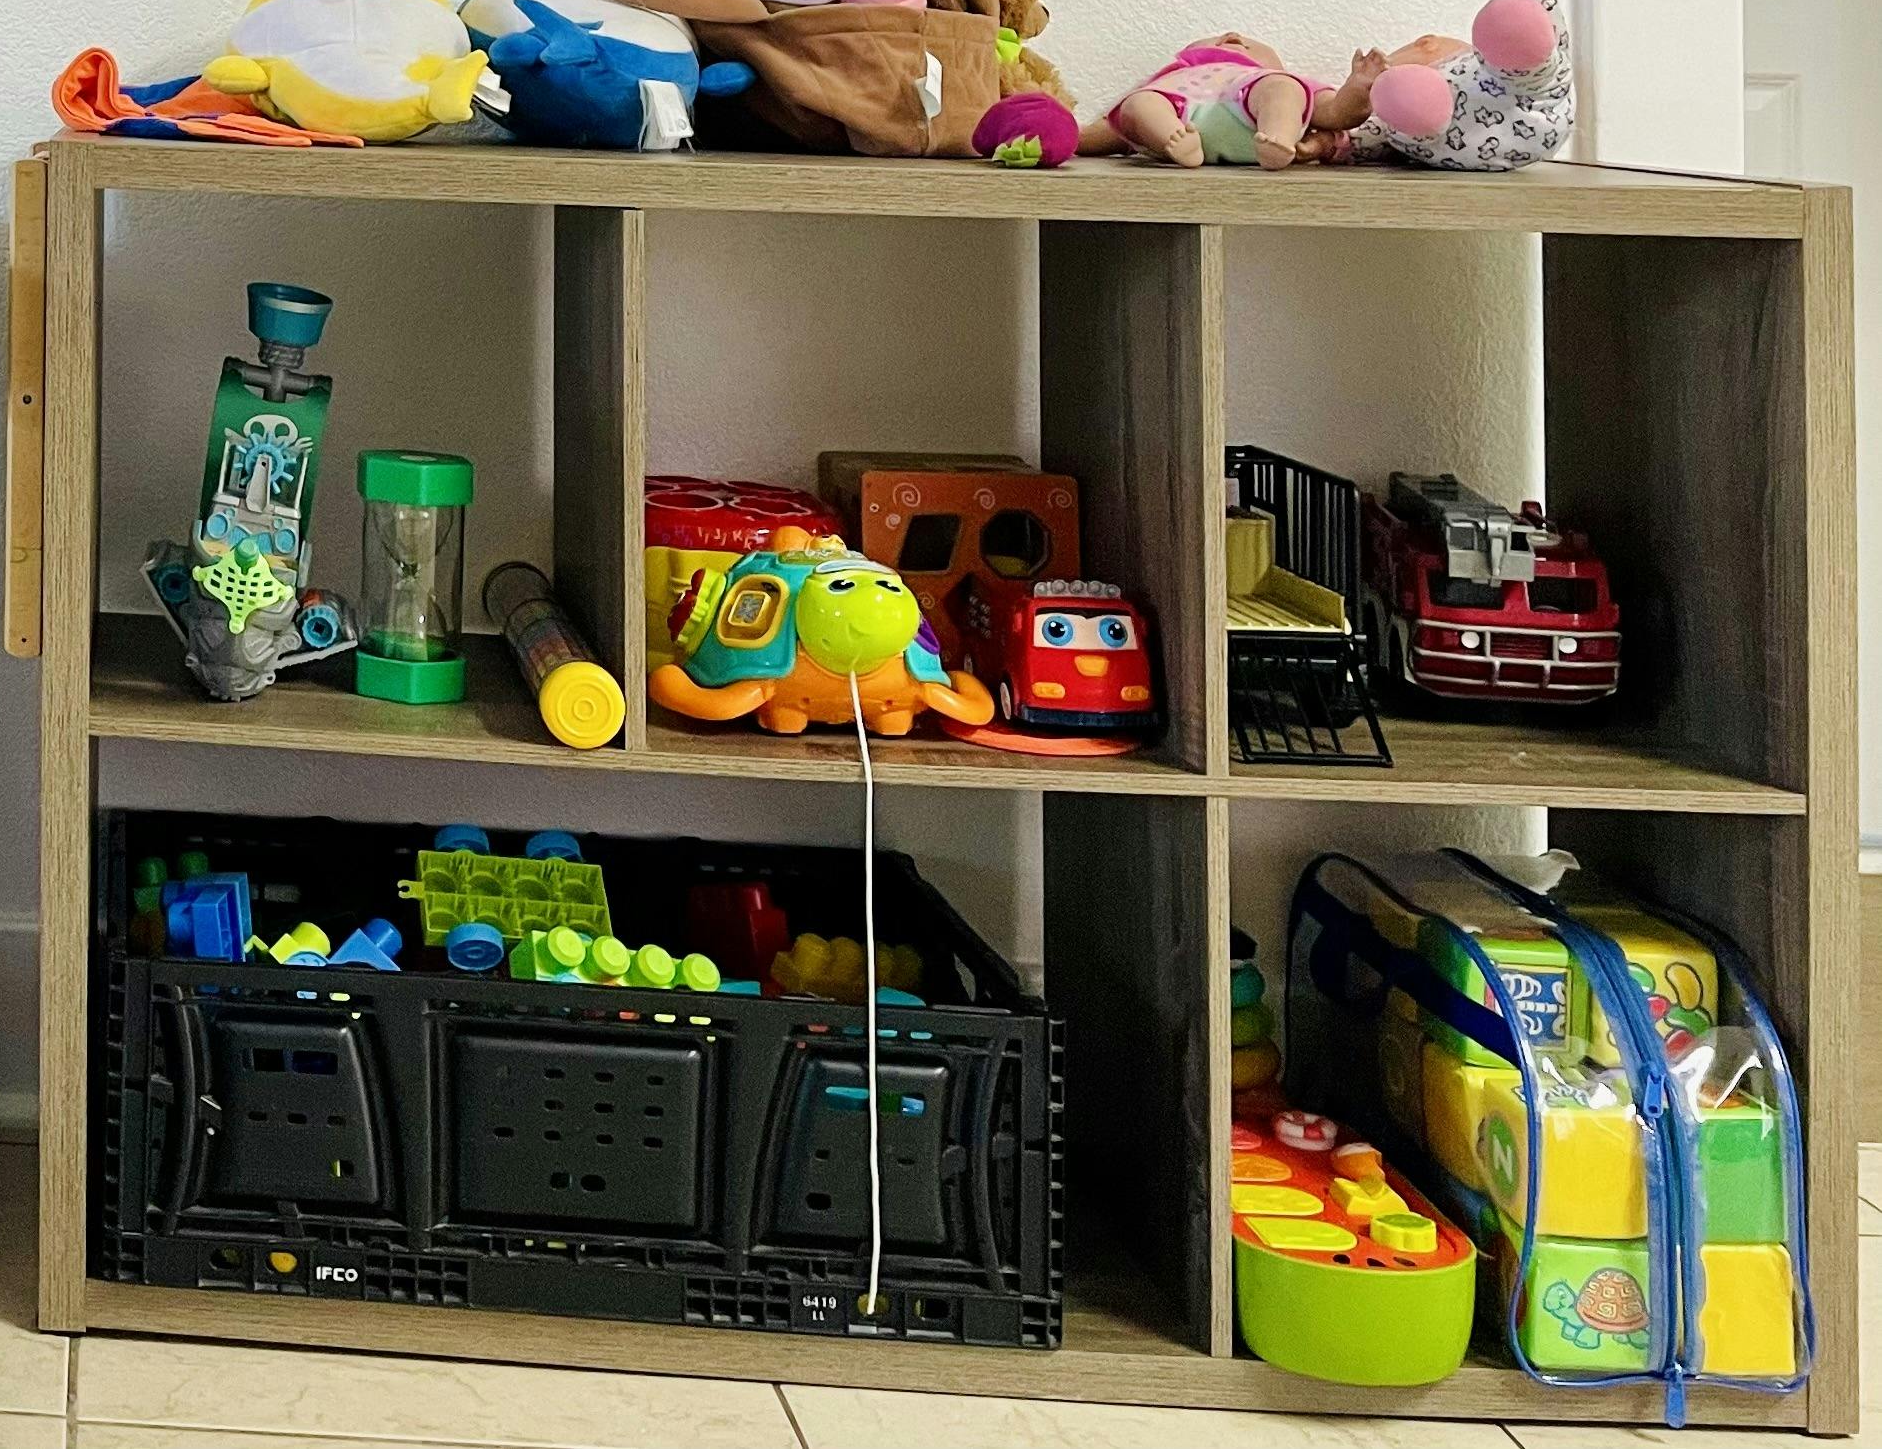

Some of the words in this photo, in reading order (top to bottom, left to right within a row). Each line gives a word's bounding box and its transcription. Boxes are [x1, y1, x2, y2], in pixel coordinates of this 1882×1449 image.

[1492, 1134, 1513, 1184] N
[316, 1266, 358, 1282] IFCO
[802, 1296, 837, 1309] 6419
